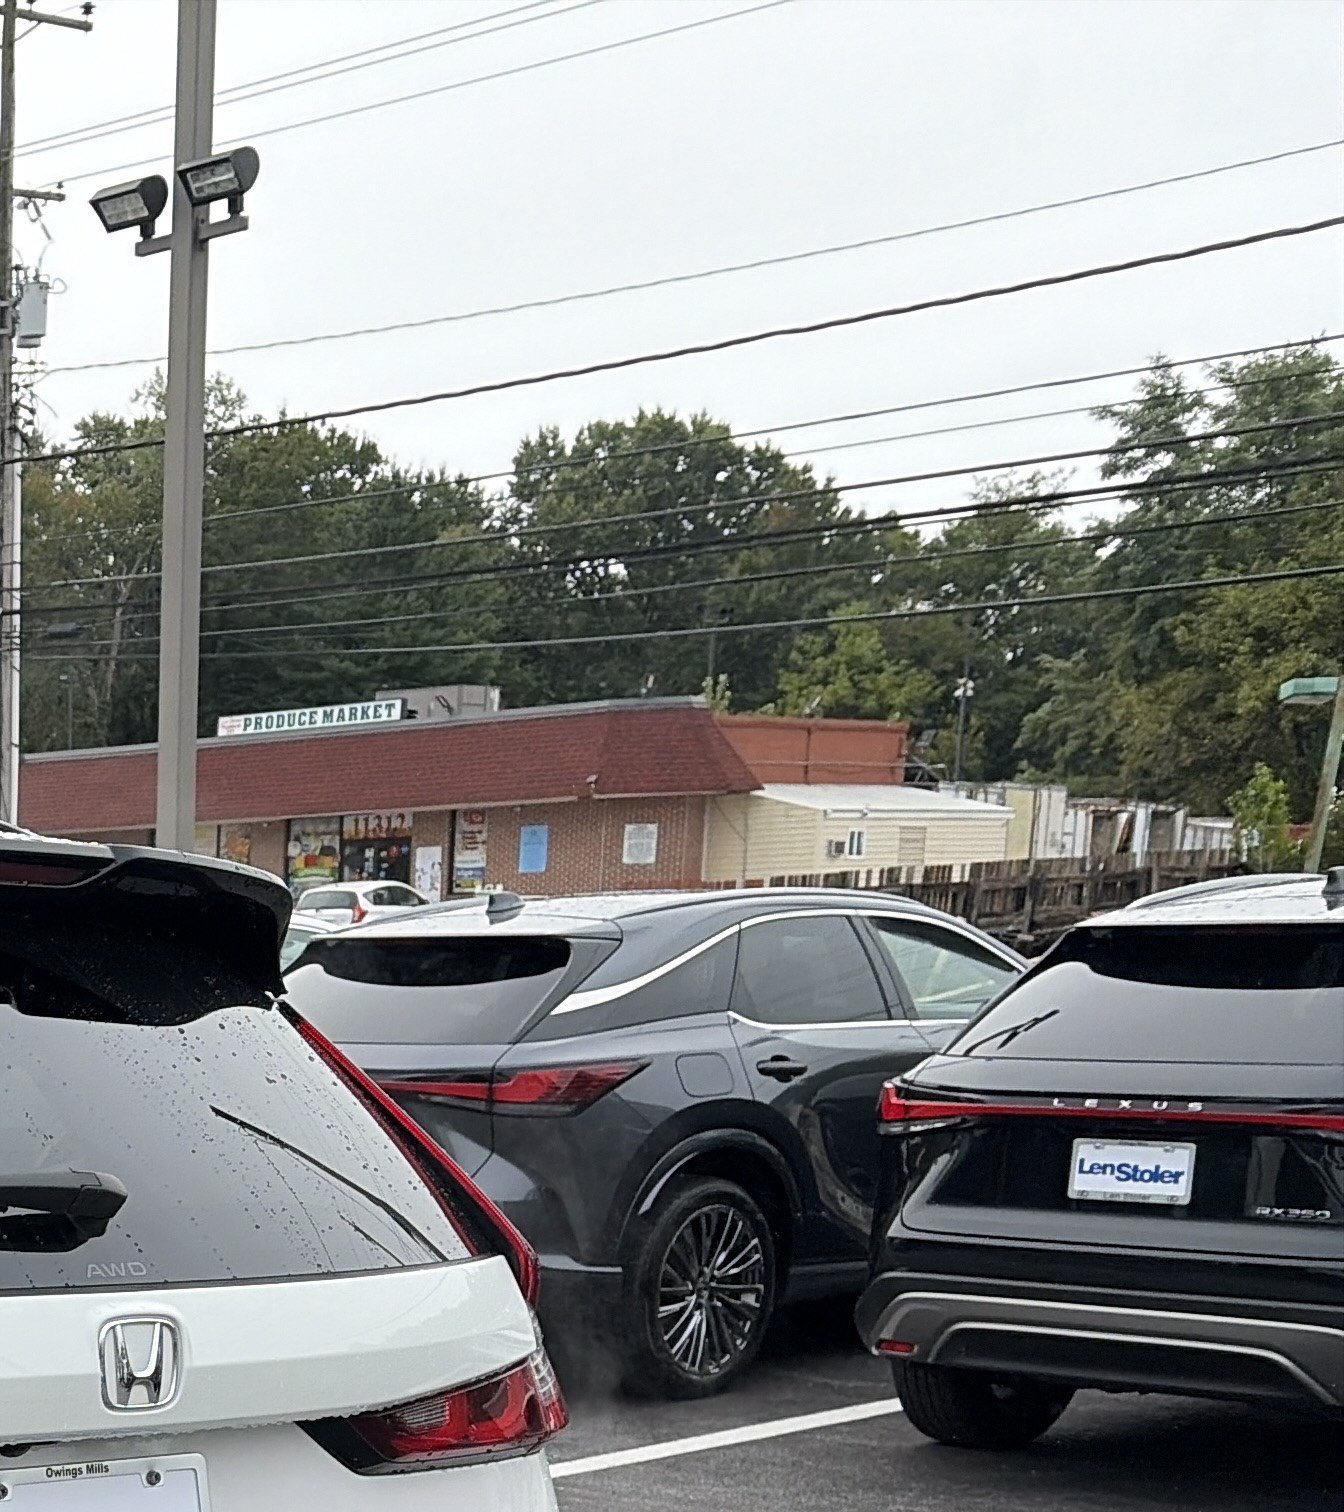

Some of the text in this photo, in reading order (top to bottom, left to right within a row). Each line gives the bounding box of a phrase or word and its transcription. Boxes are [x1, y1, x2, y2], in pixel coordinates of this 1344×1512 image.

[242, 711, 318, 732] PRODUCE
[321, 703, 396, 724] MARKET
[1052, 1098, 1205, 1112] LEXUS
[86, 1261, 148, 1279] AWD
[45, 1463, 110, 1479] Owings Mills
